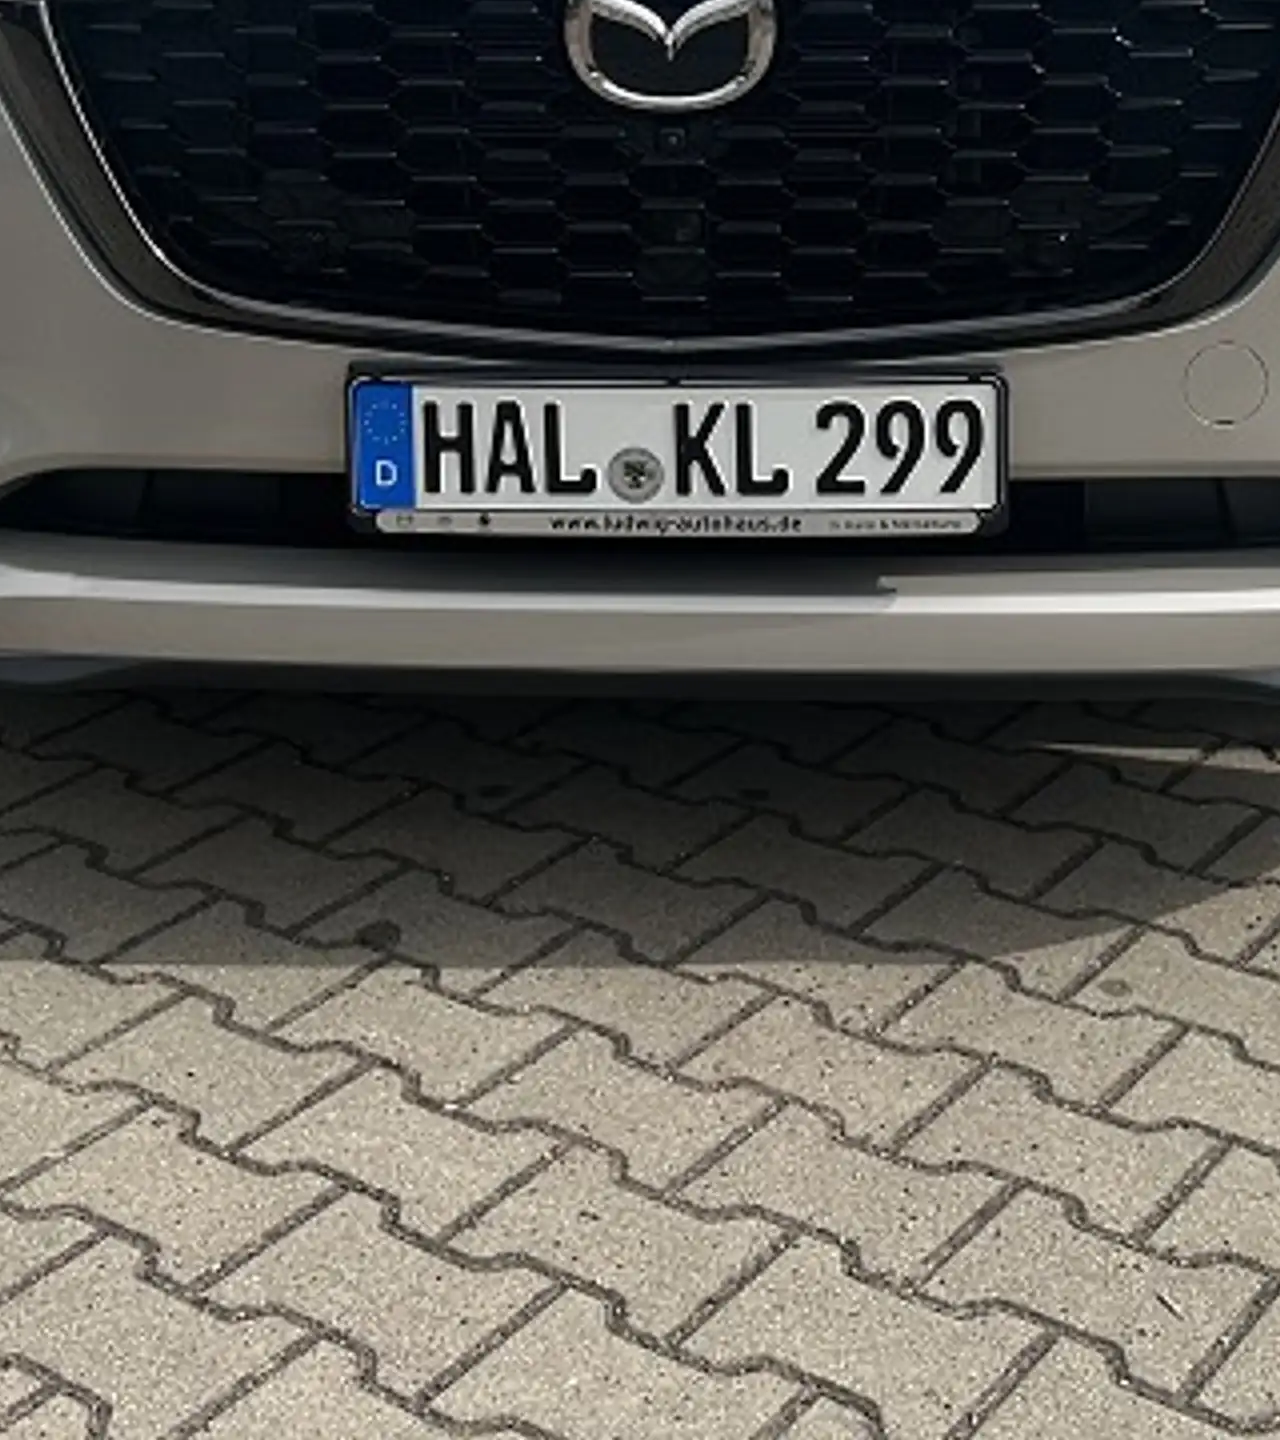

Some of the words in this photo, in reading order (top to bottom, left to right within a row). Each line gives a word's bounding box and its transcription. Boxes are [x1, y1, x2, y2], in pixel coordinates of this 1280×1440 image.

[375, 459, 397, 487] D
[421, 400, 598, 496] HAL
[673, 400, 790, 496] KL
[815, 398, 984, 495] 299
